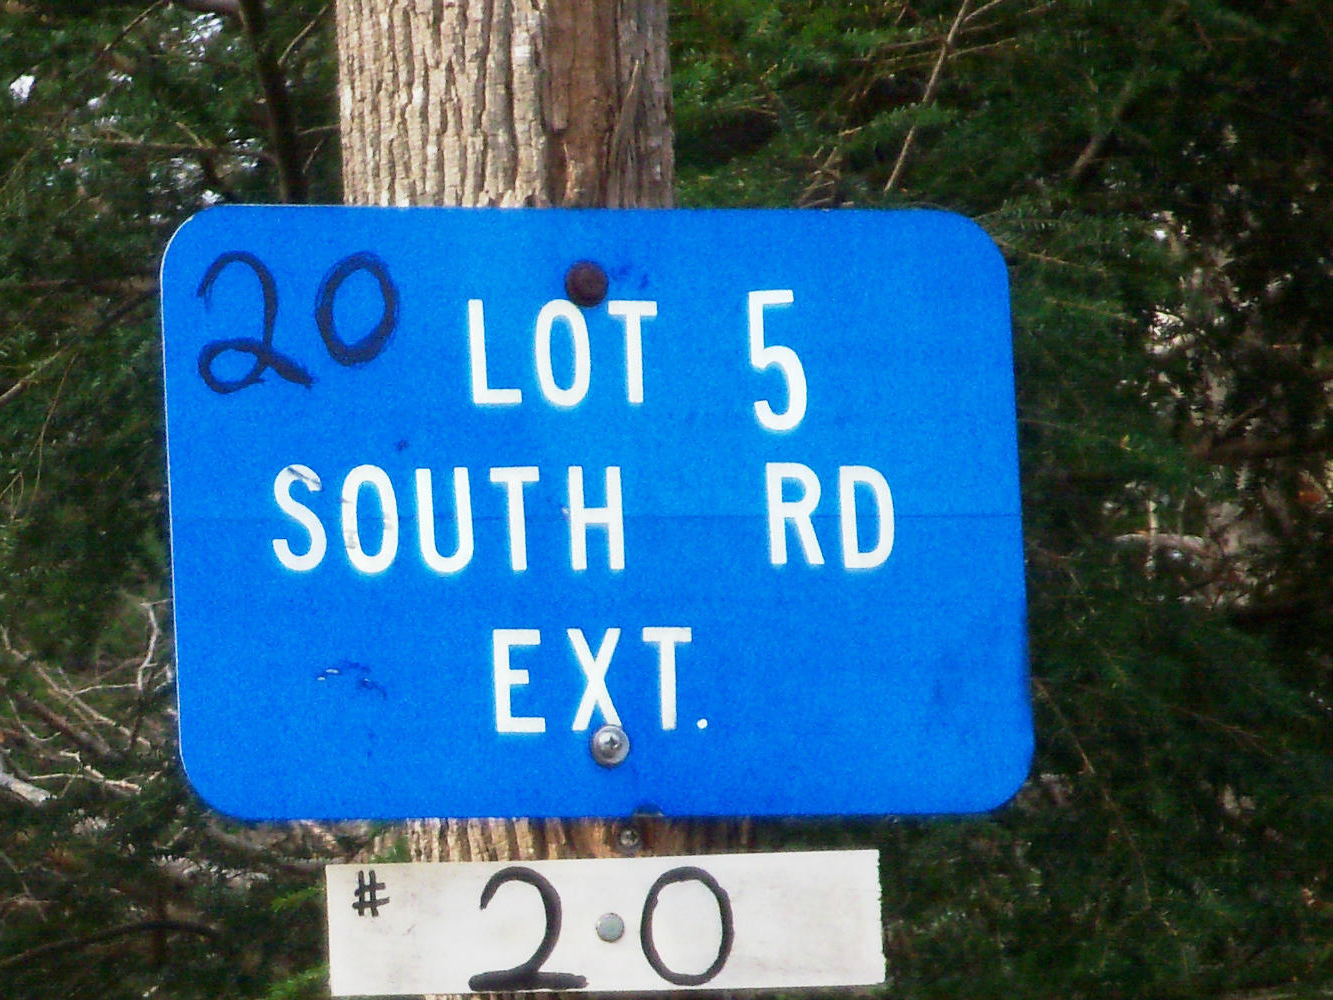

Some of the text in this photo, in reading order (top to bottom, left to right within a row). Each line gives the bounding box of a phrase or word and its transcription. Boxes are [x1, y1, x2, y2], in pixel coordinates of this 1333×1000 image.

[197, 250, 398, 395] 20
[467, 288, 808, 432] LOT 5
[271, 462, 896, 574] SOUTH RD
[491, 626, 709, 733] EXT.
[468, 866, 735, 992] 20
